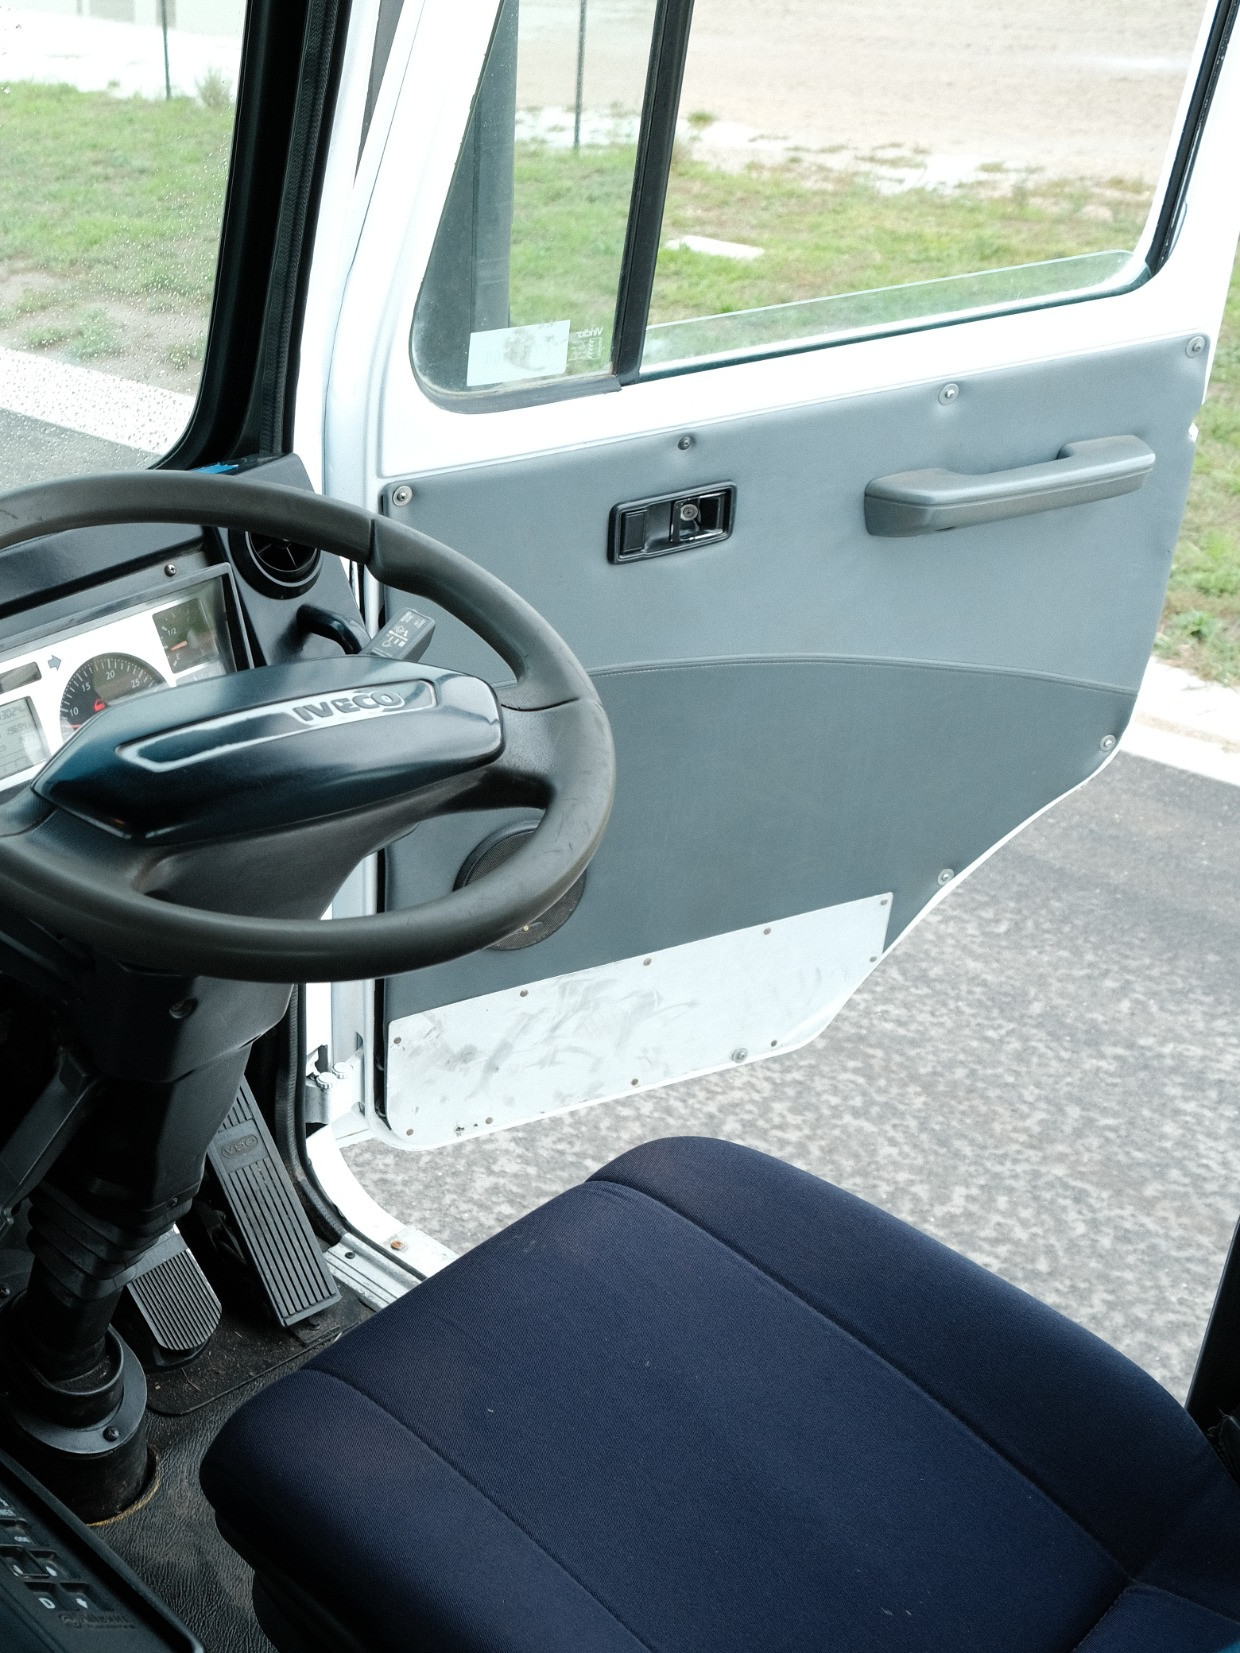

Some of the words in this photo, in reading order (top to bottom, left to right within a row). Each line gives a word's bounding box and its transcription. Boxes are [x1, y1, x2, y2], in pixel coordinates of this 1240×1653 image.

[105, 669, 116, 681] 20
[81, 681, 91, 693] 15
[130, 678, 141, 689] 25
[69, 706, 79, 717] 10
[292, 690, 403, 722] IVECO
[38, 1597, 57, 1610] D
